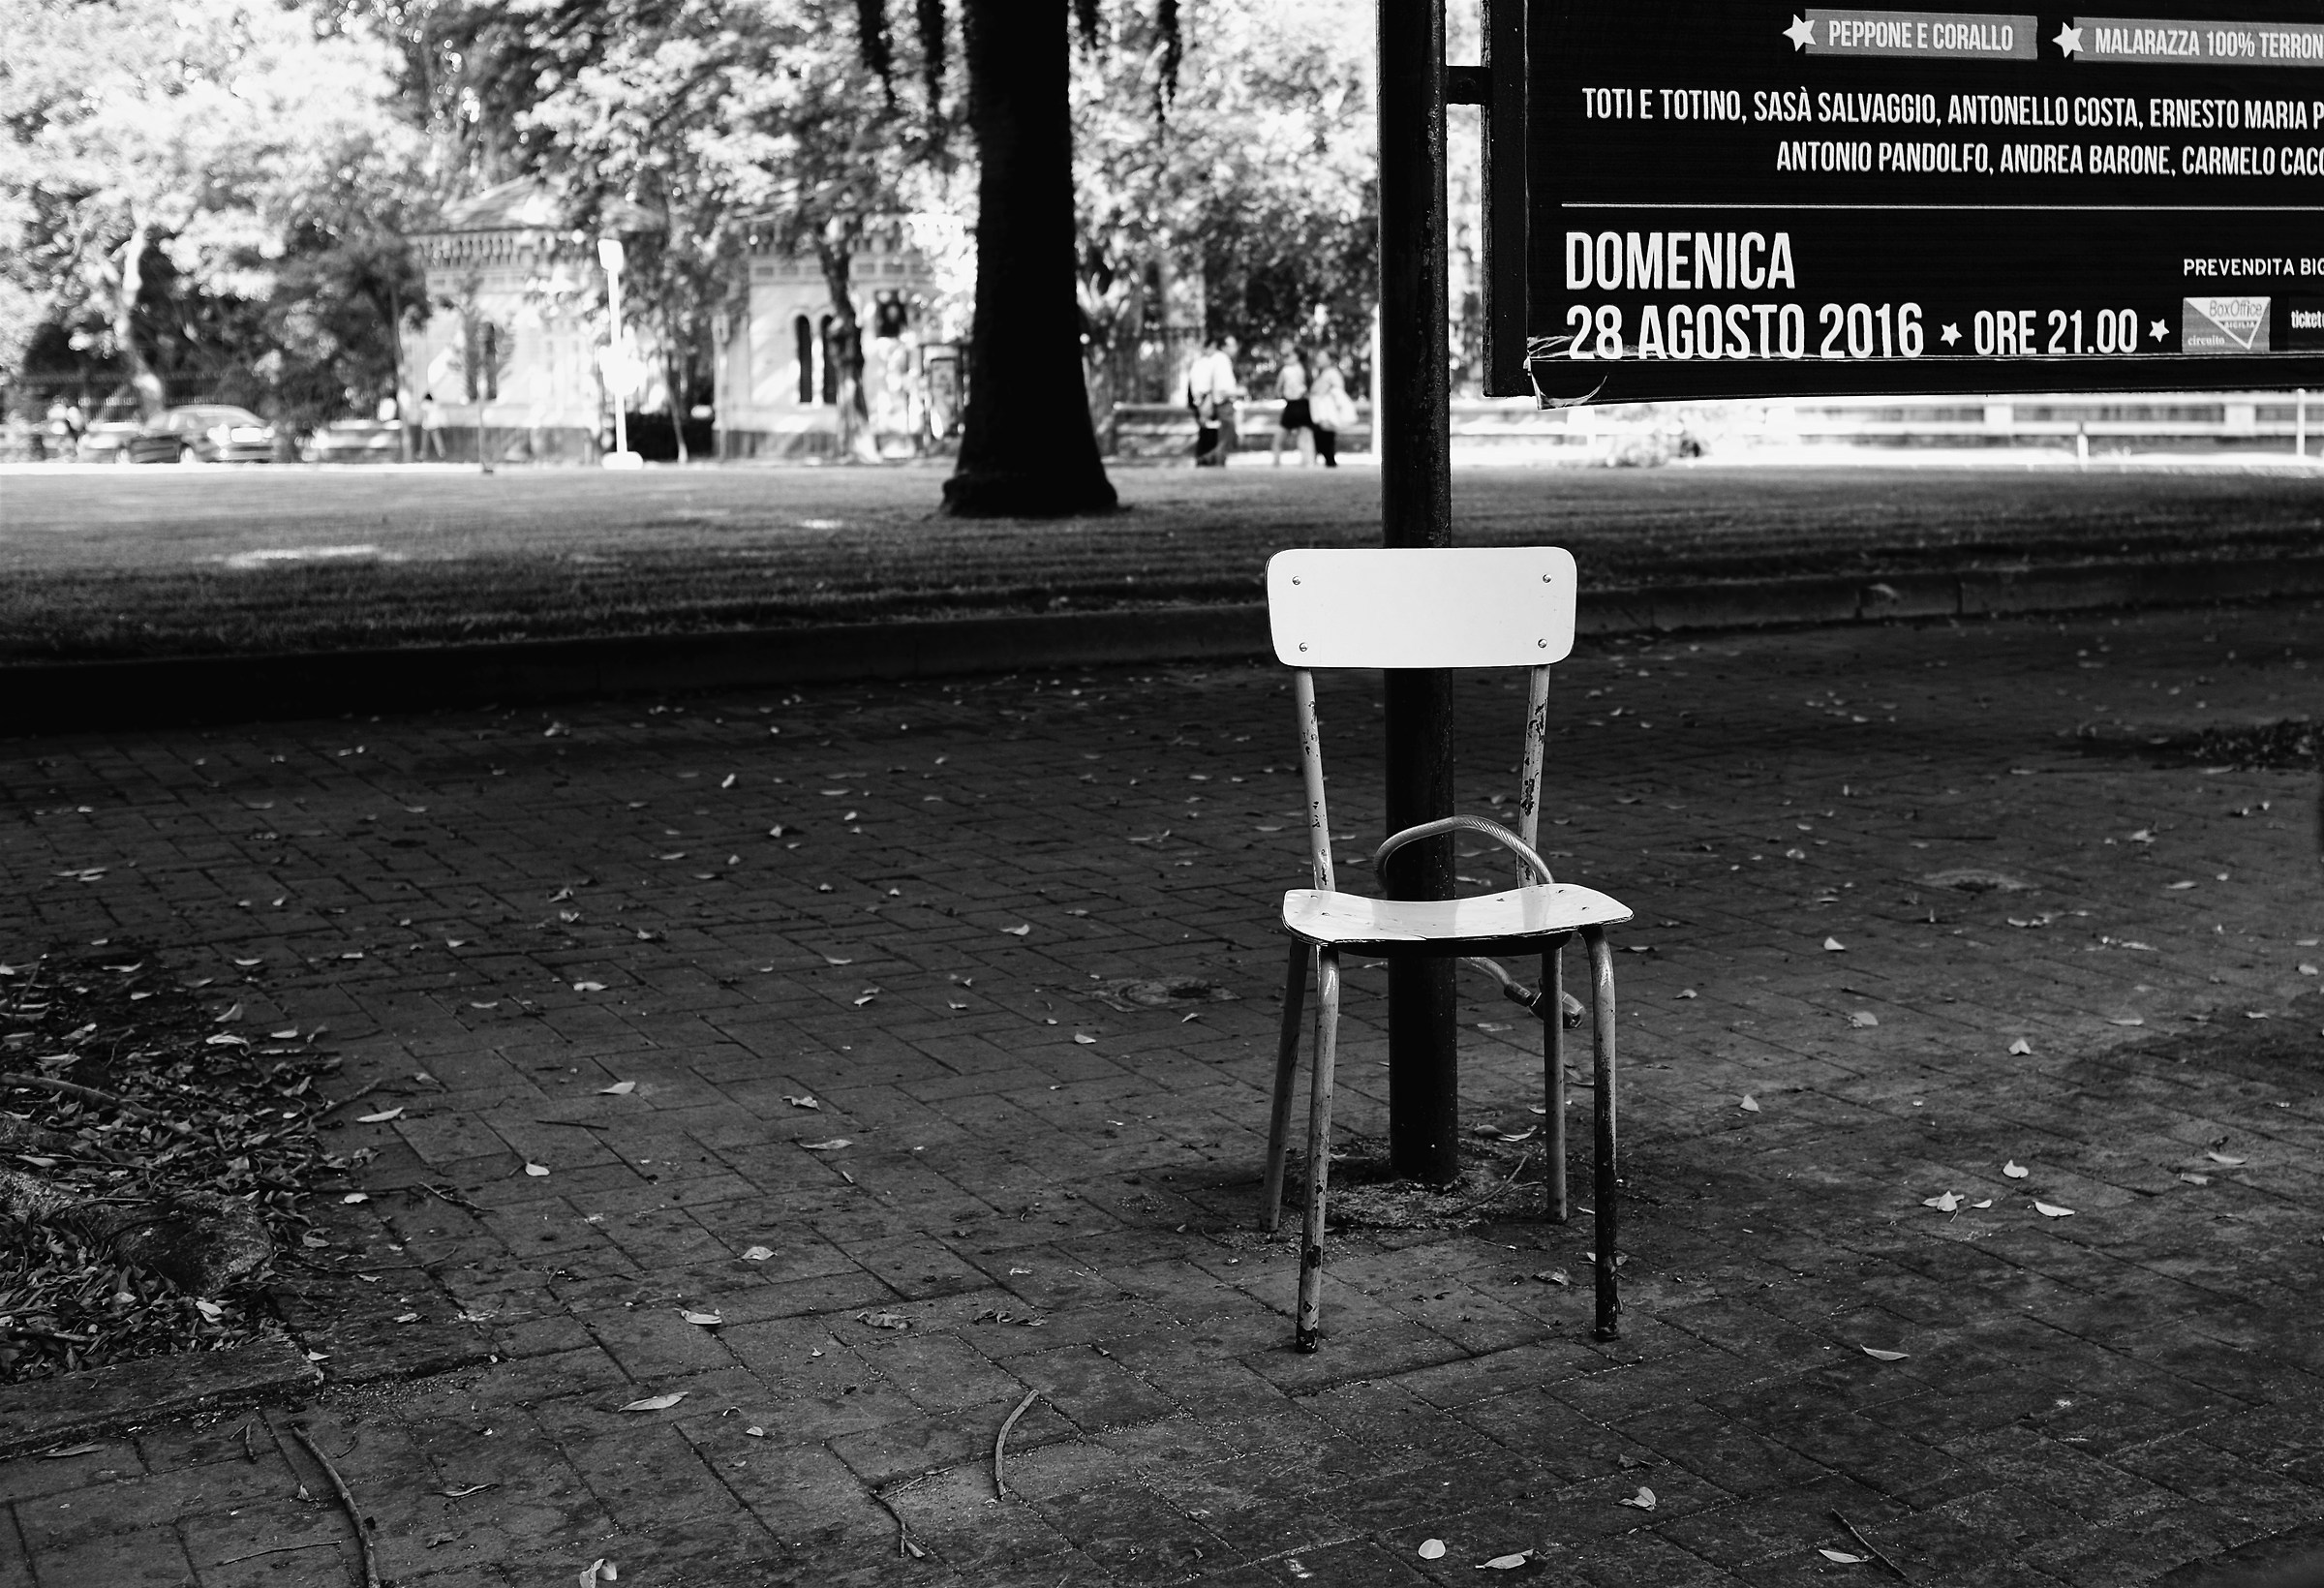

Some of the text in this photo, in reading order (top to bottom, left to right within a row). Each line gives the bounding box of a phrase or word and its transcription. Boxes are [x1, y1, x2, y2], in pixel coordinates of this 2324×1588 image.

[1828, 18, 2014, 52] PEPPONE E CORALLO
[2095, 27, 2201, 57] MALARAZZA
[2206, 29, 2256, 58] 100%
[1581, 87, 1634, 120] TOTI
[1639, 88, 1654, 120] E
[1659, 88, 1748, 125] TOTINO,
[1754, 85, 1813, 123] SASÀ
[1818, 92, 1942, 127] SALVAGGIO,
[1947, 94, 2069, 126] ANTONELLO
[2074, 96, 2145, 131] COSTA,
[2150, 98, 2241, 130] ERNESTO
[2245, 100, 2309, 131] MARIA
[1776, 140, 1873, 172] ANTONIO
[1879, 141, 1995, 176] PANDOLFO,
[2000, 143, 2084, 174] ANDREA
[2089, 144, 2177, 178] BARONE,
[2182, 145, 2277, 176] CARMELO
[1566, 230, 1796, 290] DOMENICA
[2183, 258, 2295, 277] PREVENDITA
[2209, 299, 2263, 318] BoxOffice
[1566, 302, 2138, 360] 28 AGOSTO 2016 ORE 21.00
[2186, 335, 2226, 347] circuito
